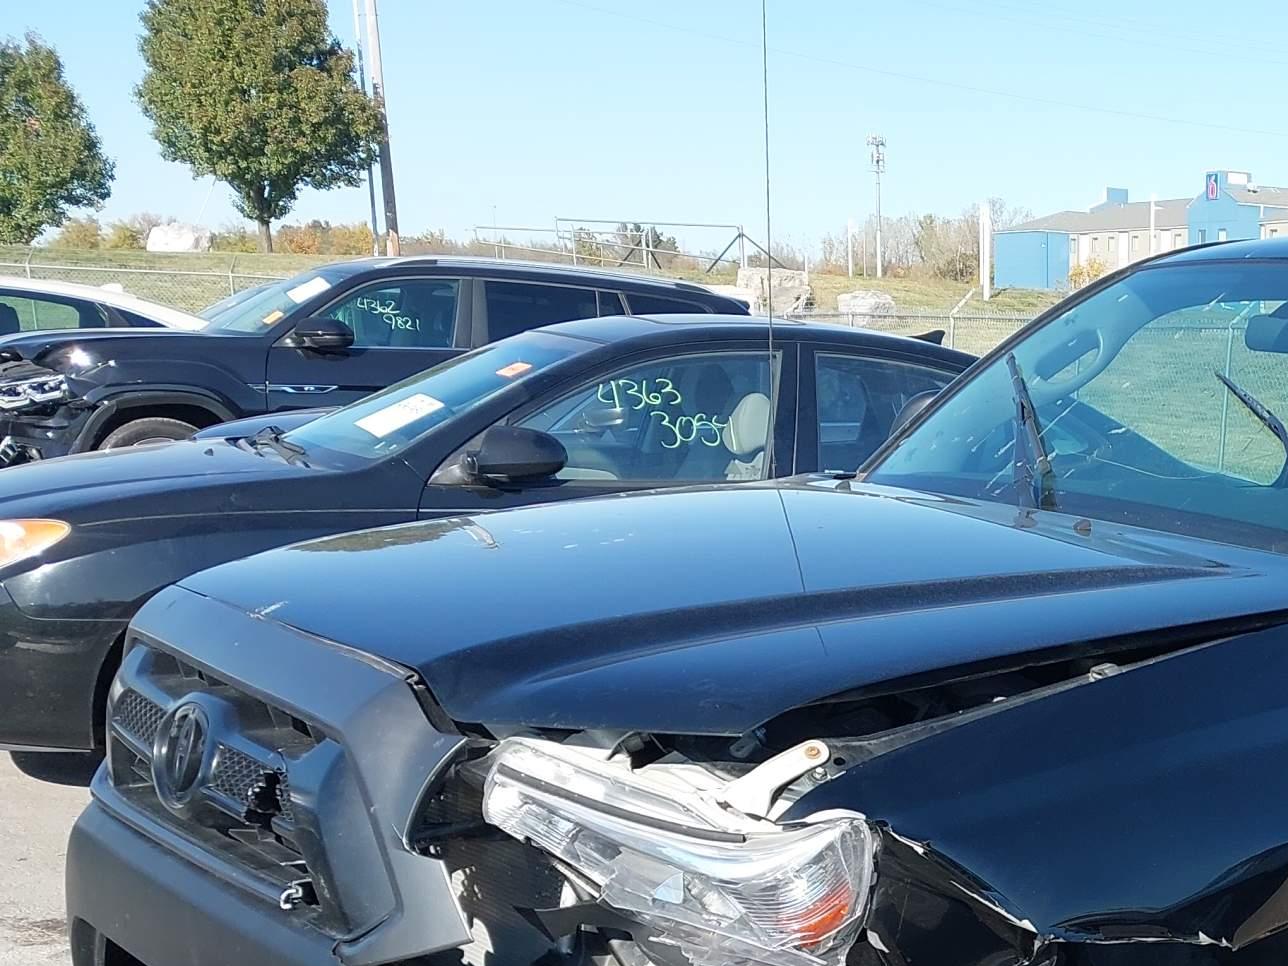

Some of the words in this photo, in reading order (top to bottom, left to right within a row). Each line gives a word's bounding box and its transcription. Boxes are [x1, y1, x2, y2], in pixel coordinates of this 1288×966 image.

[357, 297, 400, 314] 4362
[383, 314, 420, 332] 9821
[597, 378, 682, 410] 4363
